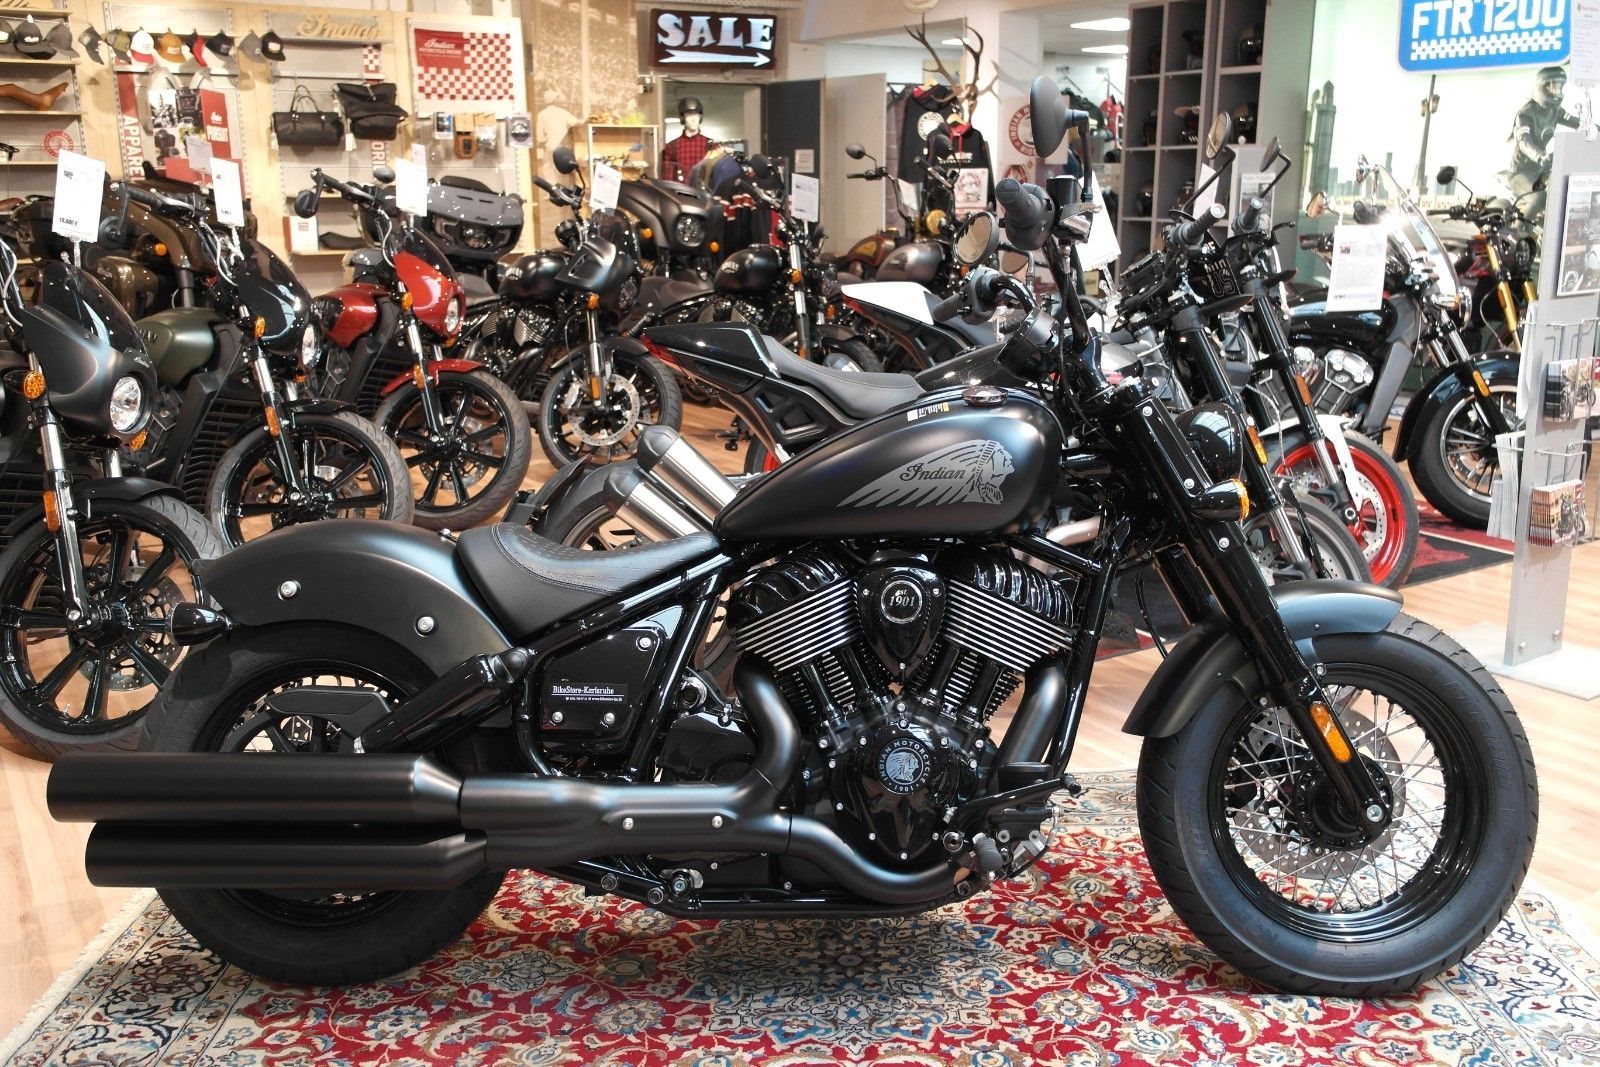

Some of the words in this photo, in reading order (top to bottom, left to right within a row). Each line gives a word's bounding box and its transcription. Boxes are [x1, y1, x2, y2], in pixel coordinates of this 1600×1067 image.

[297, 13, 380, 38] Indian
[656, 13, 774, 50] SALE
[1412, 1, 1472, 39] FTR
[1475, 0, 1565, 33] 1200
[899, 462, 966, 482] Indian
[889, 595, 915, 607] 1901
[552, 685, 615, 695] BikeStore-Karlsruhe
[879, 746, 892, 782] INDIAN
[893, 740, 931, 784] MOTORCYCLE
